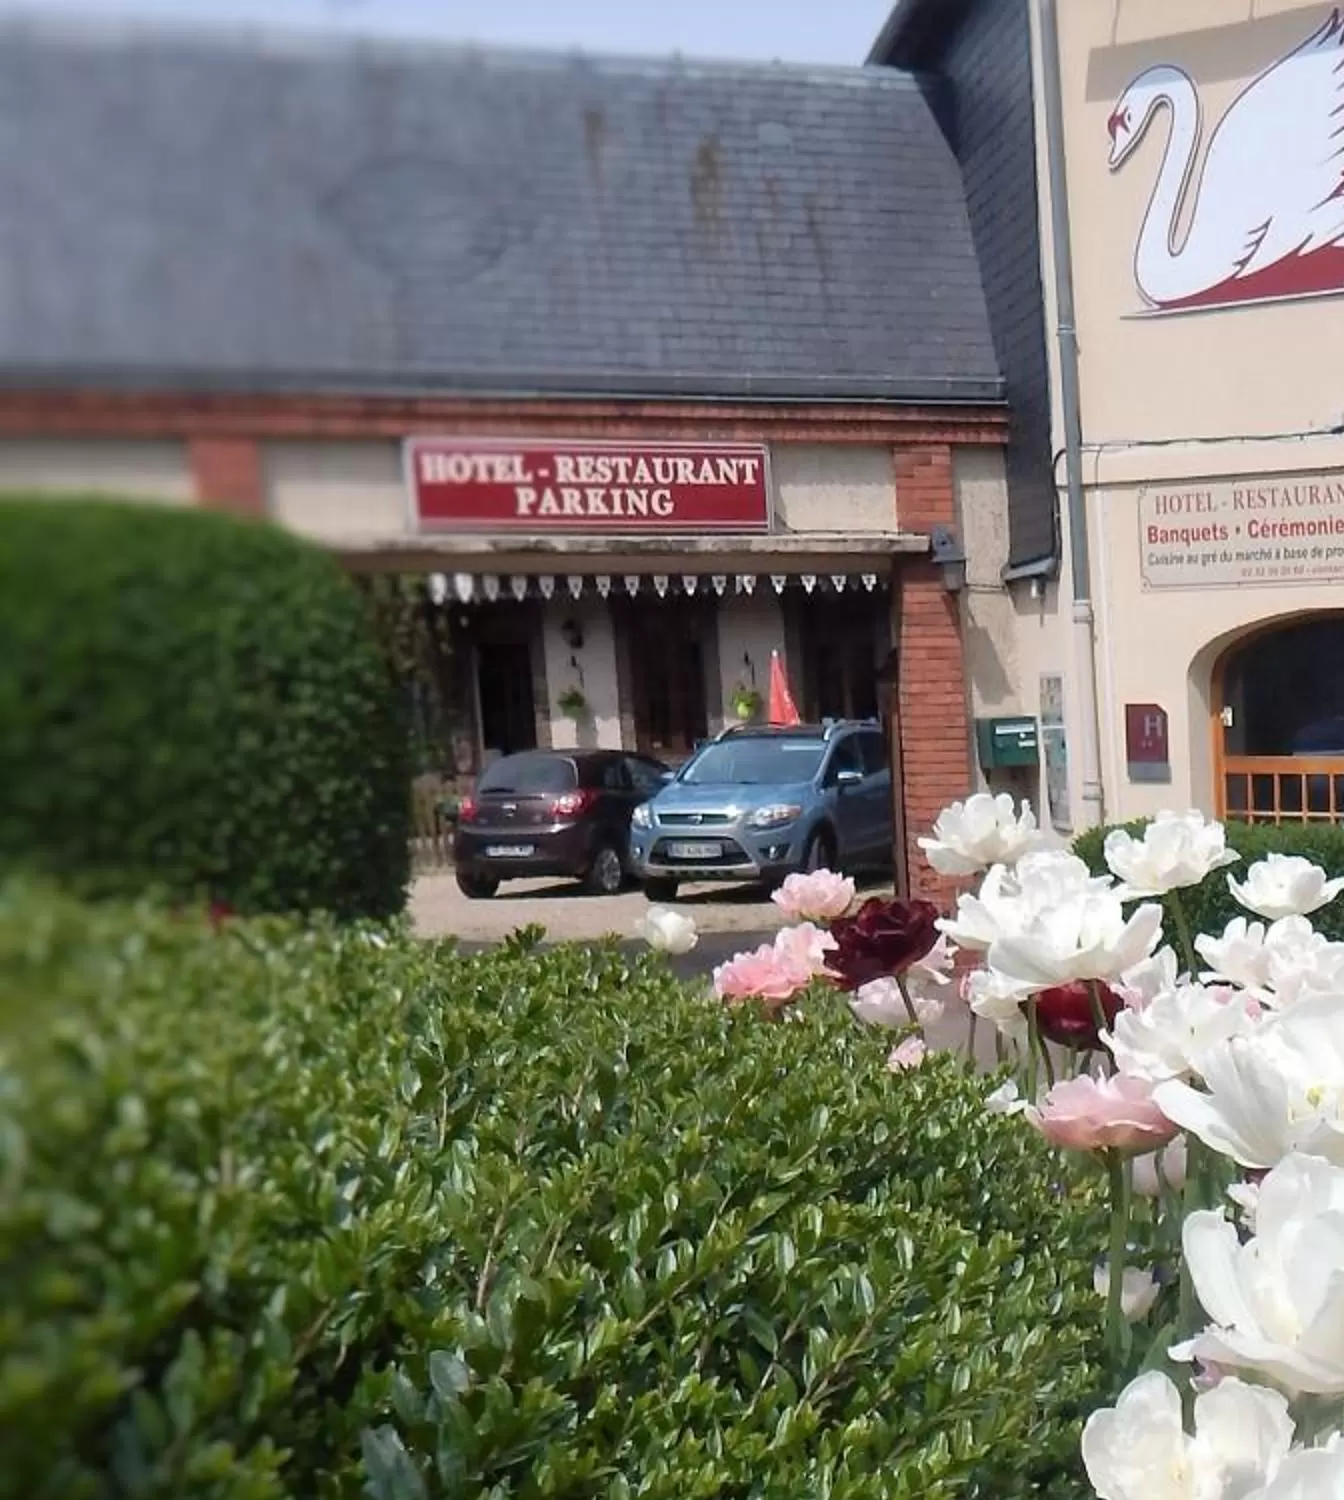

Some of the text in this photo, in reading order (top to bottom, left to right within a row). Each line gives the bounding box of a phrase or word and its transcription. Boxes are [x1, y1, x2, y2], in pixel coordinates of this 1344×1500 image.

[420, 452, 532, 484] HOTEL
[554, 454, 760, 485] RESTAURANT
[515, 487, 674, 517] PARKING
[1155, 492, 1217, 515] HOTEL
[1147, 523, 1229, 547] Banquets
[1147, 552, 1185, 567] Cuisine
[1186, 554, 1199, 565] au
[1200, 551, 1217, 567] gré
[1220, 550, 1233, 563] du
[1235, 547, 1272, 562] marché
[1283, 546, 1308, 561] base
[1310, 545, 1323, 558] de
[1144, 715, 1163, 737] H
